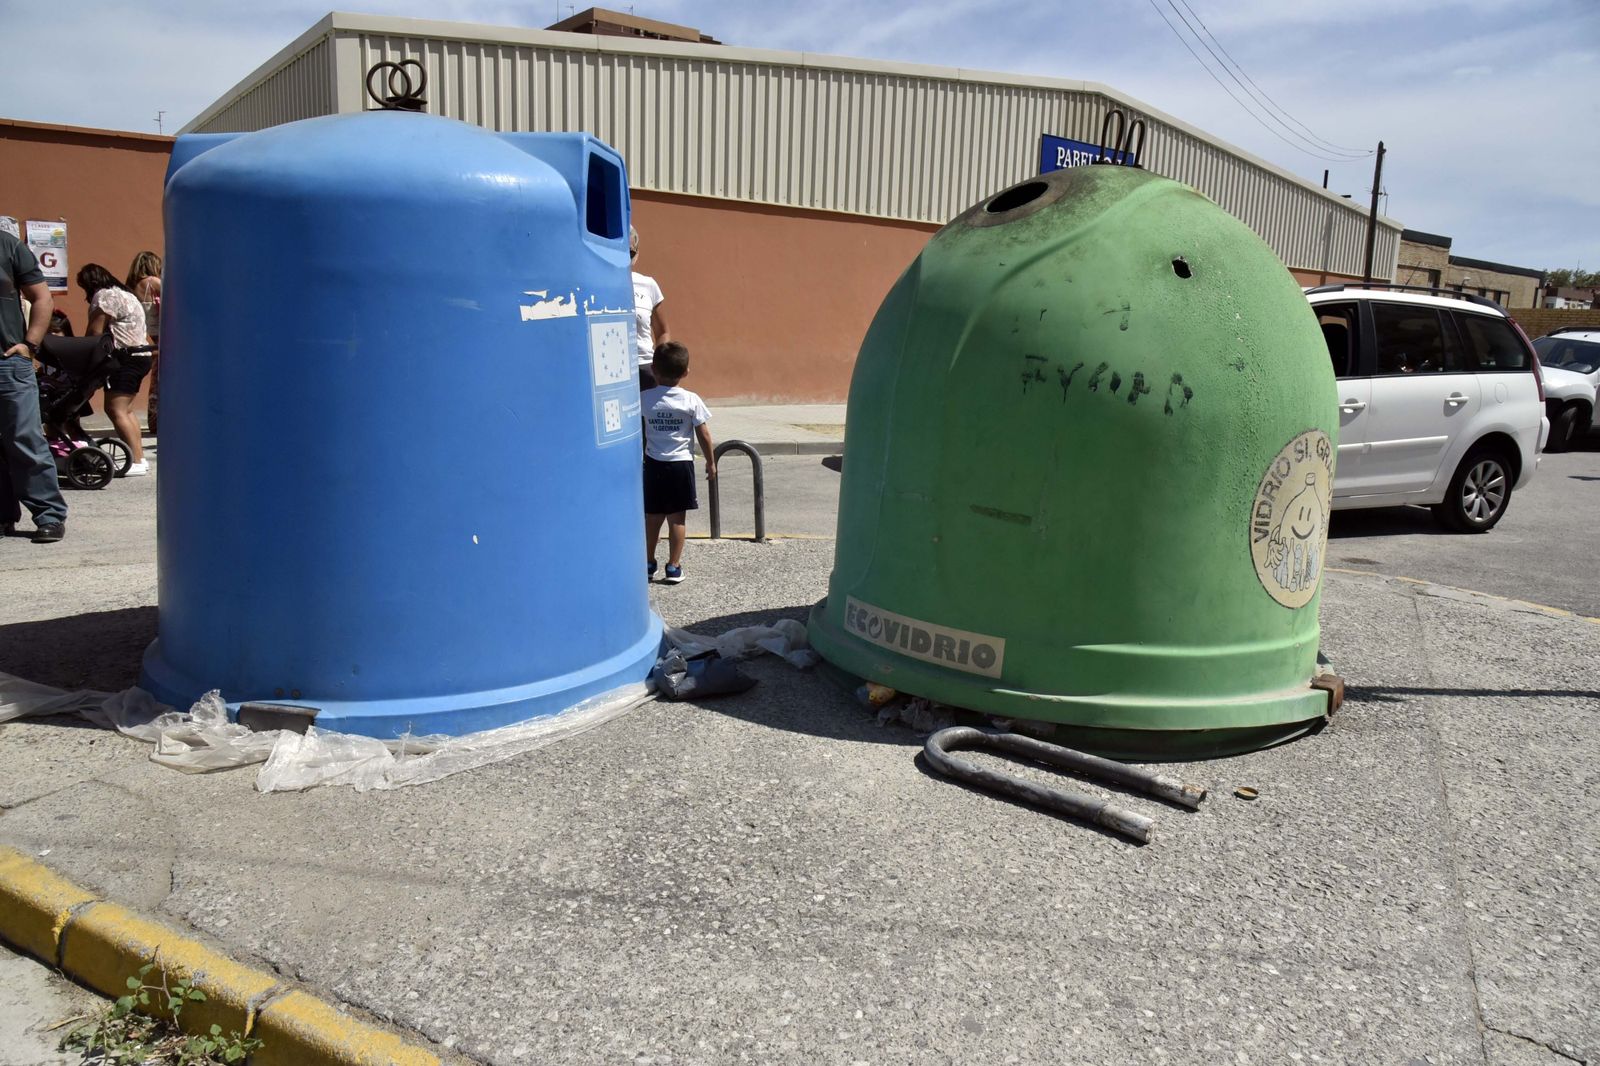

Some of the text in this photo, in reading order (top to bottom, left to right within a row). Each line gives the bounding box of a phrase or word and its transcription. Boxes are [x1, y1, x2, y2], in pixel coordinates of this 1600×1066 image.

[40, 252, 57, 268] G
[1254, 456, 1291, 543] VIDRIO
[847, 603, 996, 669] ECOVIDRIO
